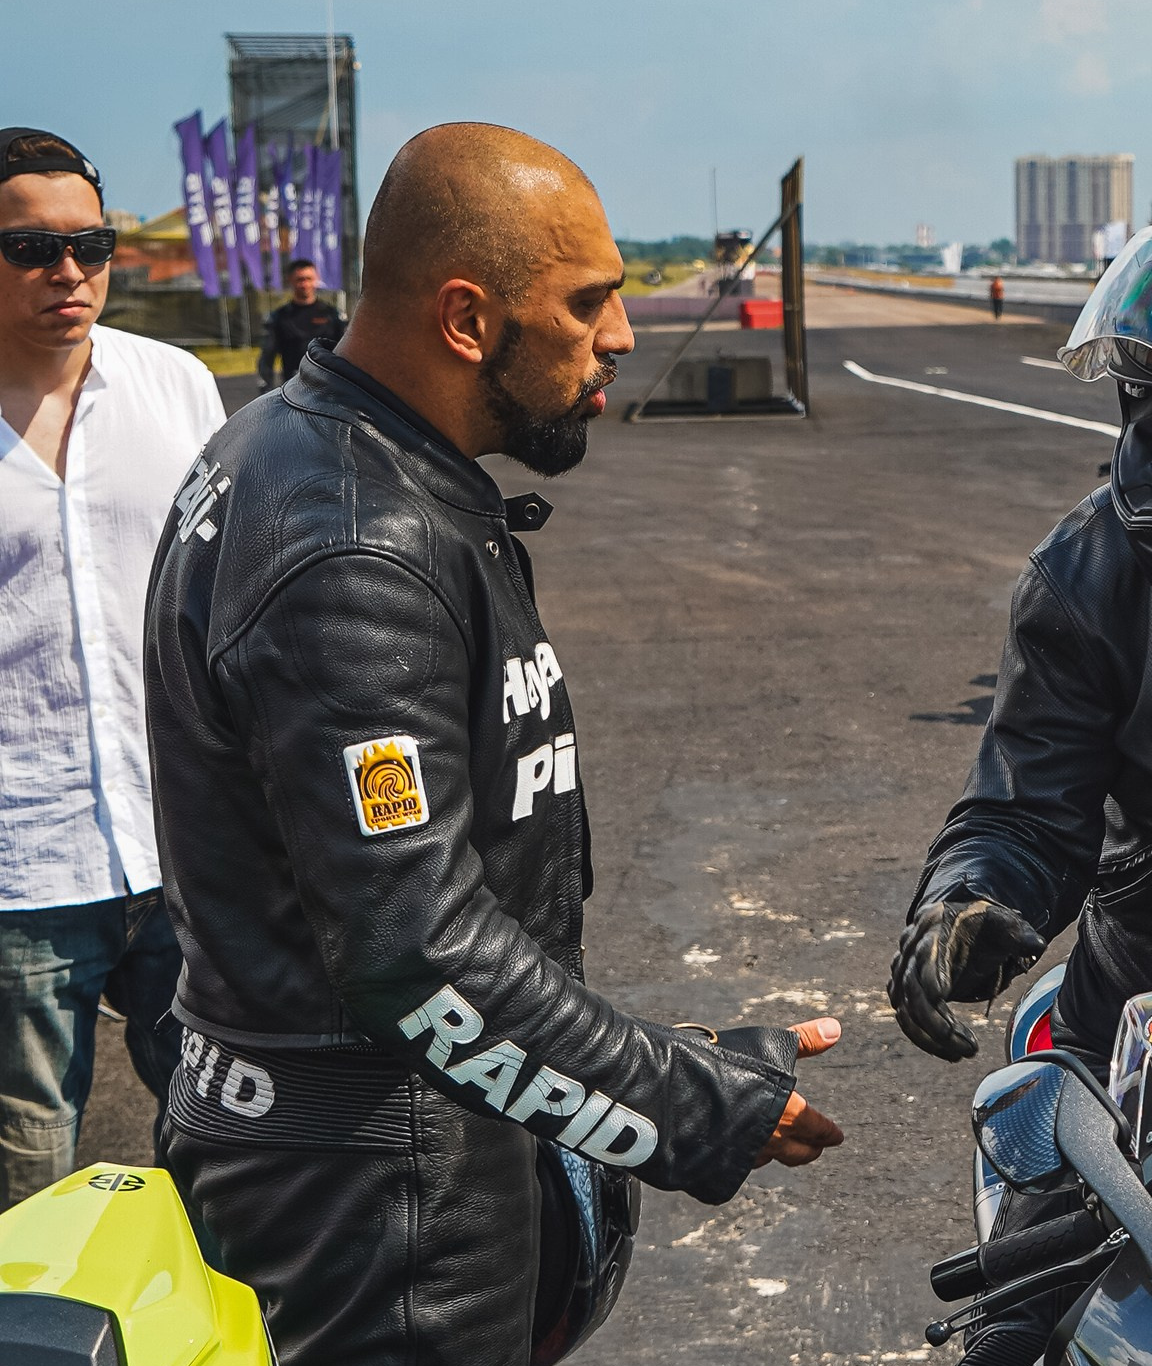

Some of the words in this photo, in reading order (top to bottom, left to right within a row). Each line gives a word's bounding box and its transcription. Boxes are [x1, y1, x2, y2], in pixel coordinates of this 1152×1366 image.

[370, 797, 417, 818] RAPID
[181, 1026, 276, 1118] PID
[397, 983, 659, 1167] RAPID
